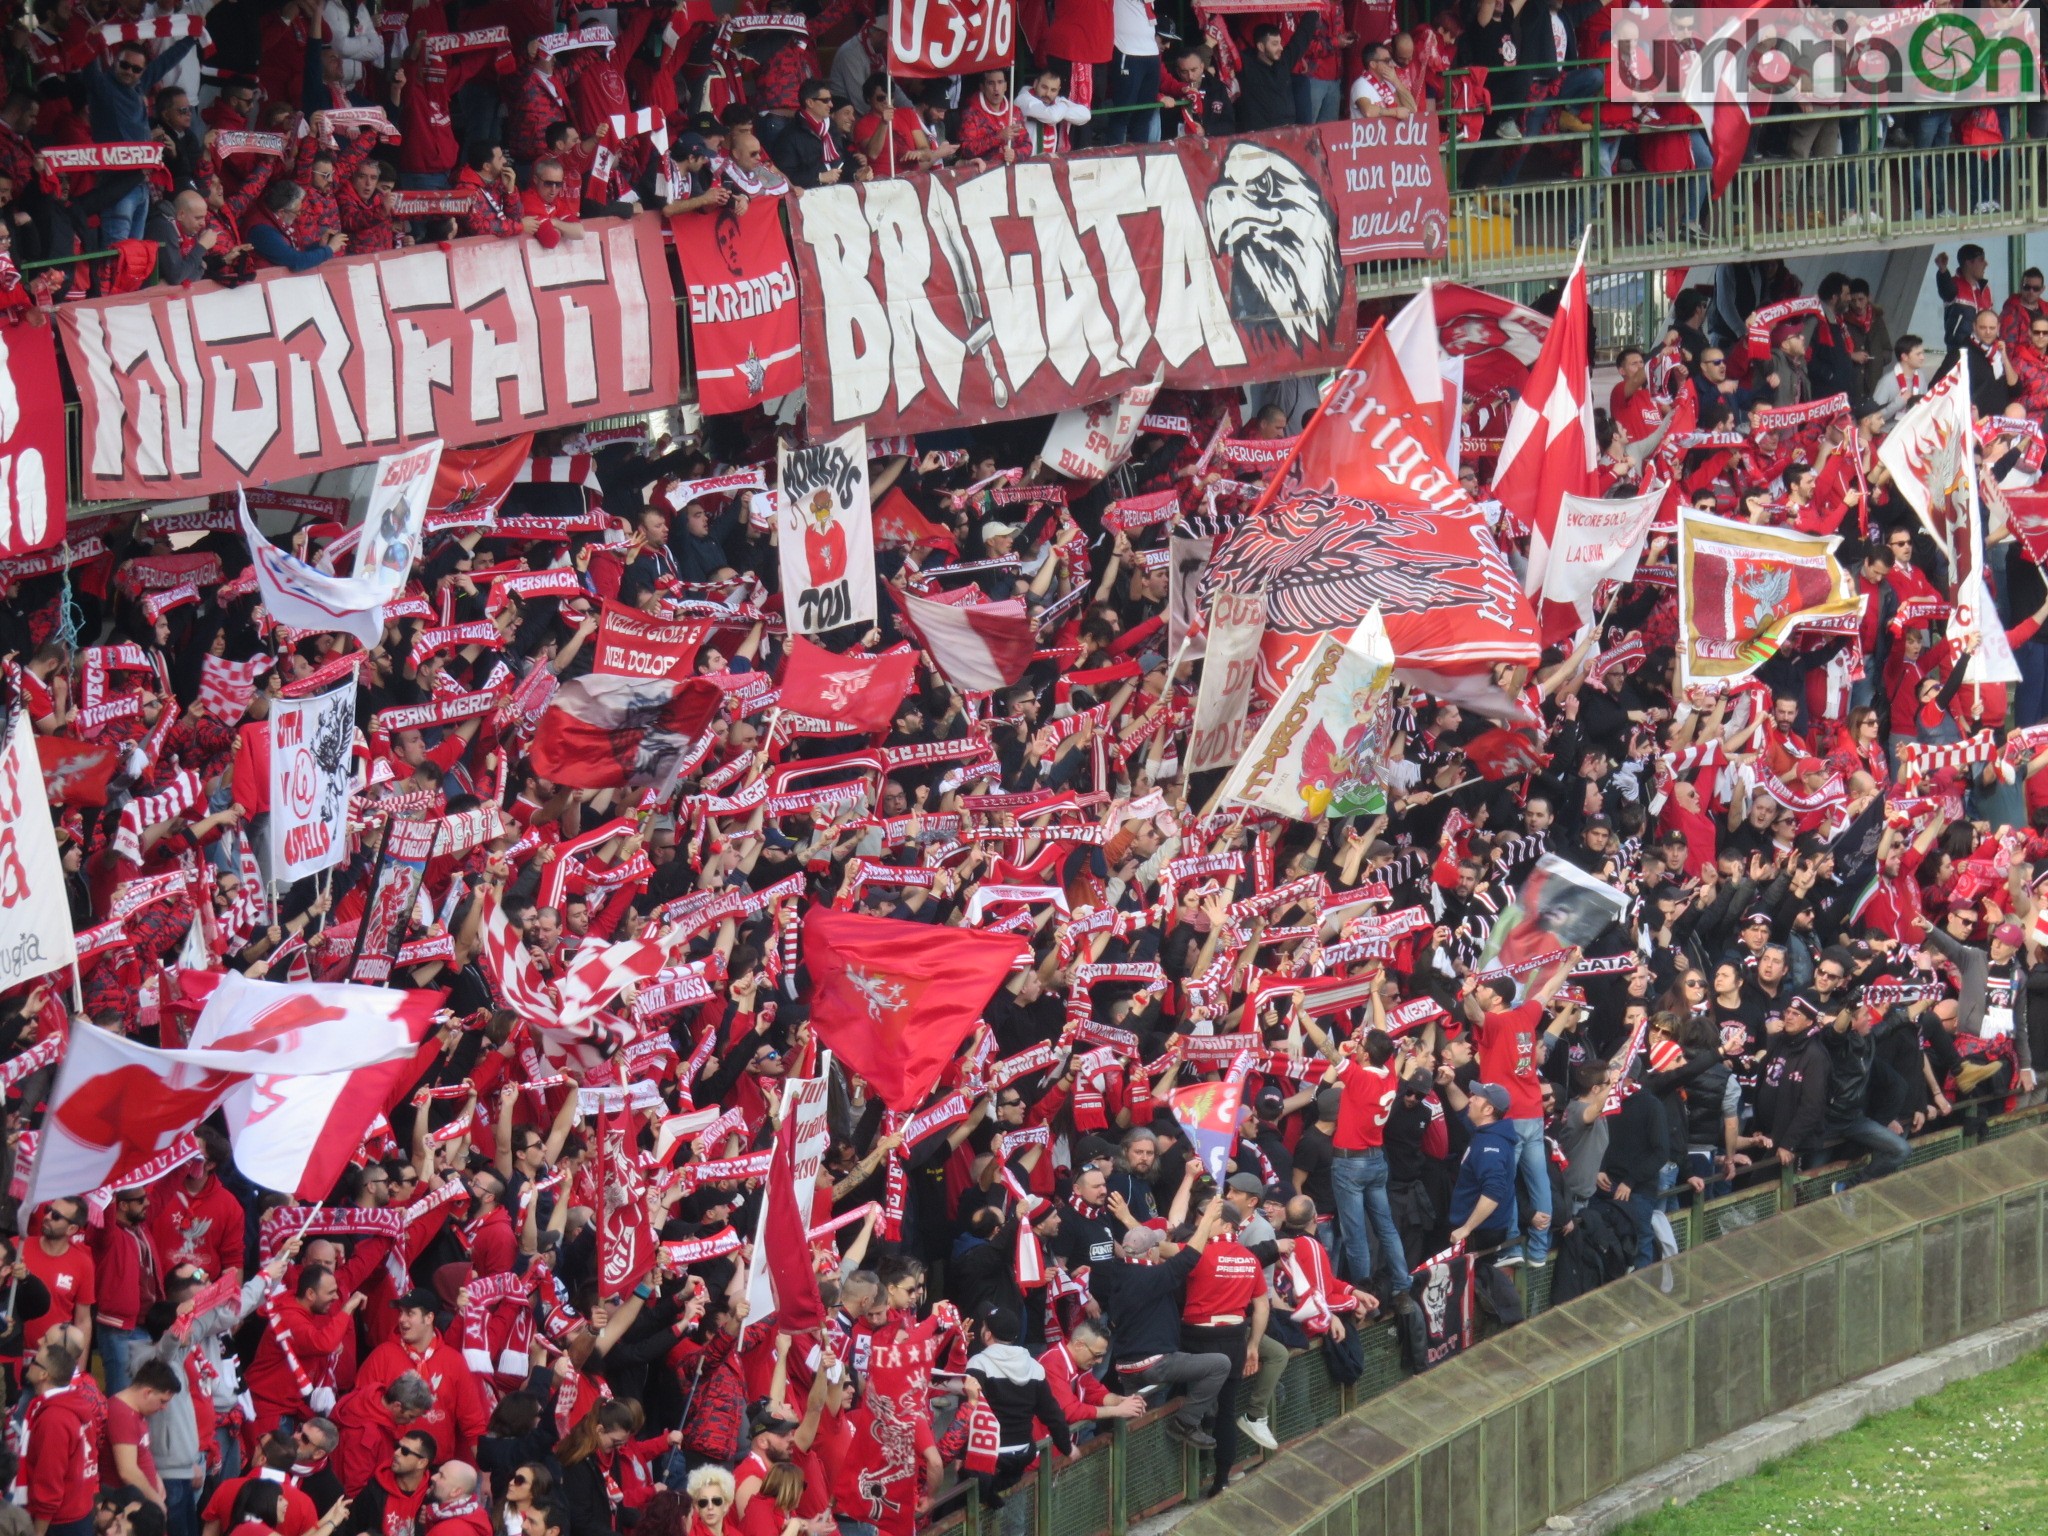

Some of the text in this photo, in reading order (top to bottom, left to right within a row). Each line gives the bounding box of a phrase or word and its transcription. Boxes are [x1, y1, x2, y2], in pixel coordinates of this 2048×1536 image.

[782, 13, 807, 30] GLOR
[463, 26, 508, 48] MERD
[1394, 111, 1429, 146] chi
[48, 147, 100, 168] TERNI
[1344, 163, 1387, 194] non
[801, 154, 1248, 421] BRIGATA
[1143, 413, 1189, 431] MERD
[1761, 394, 1851, 430] PERUGIA PERUGIA
[52, 535, 103, 568] MERD
[604, 612, 645, 637] NELLA
[604, 644, 626, 668] NEL
[379, 692, 497, 730] TERNI MERD
